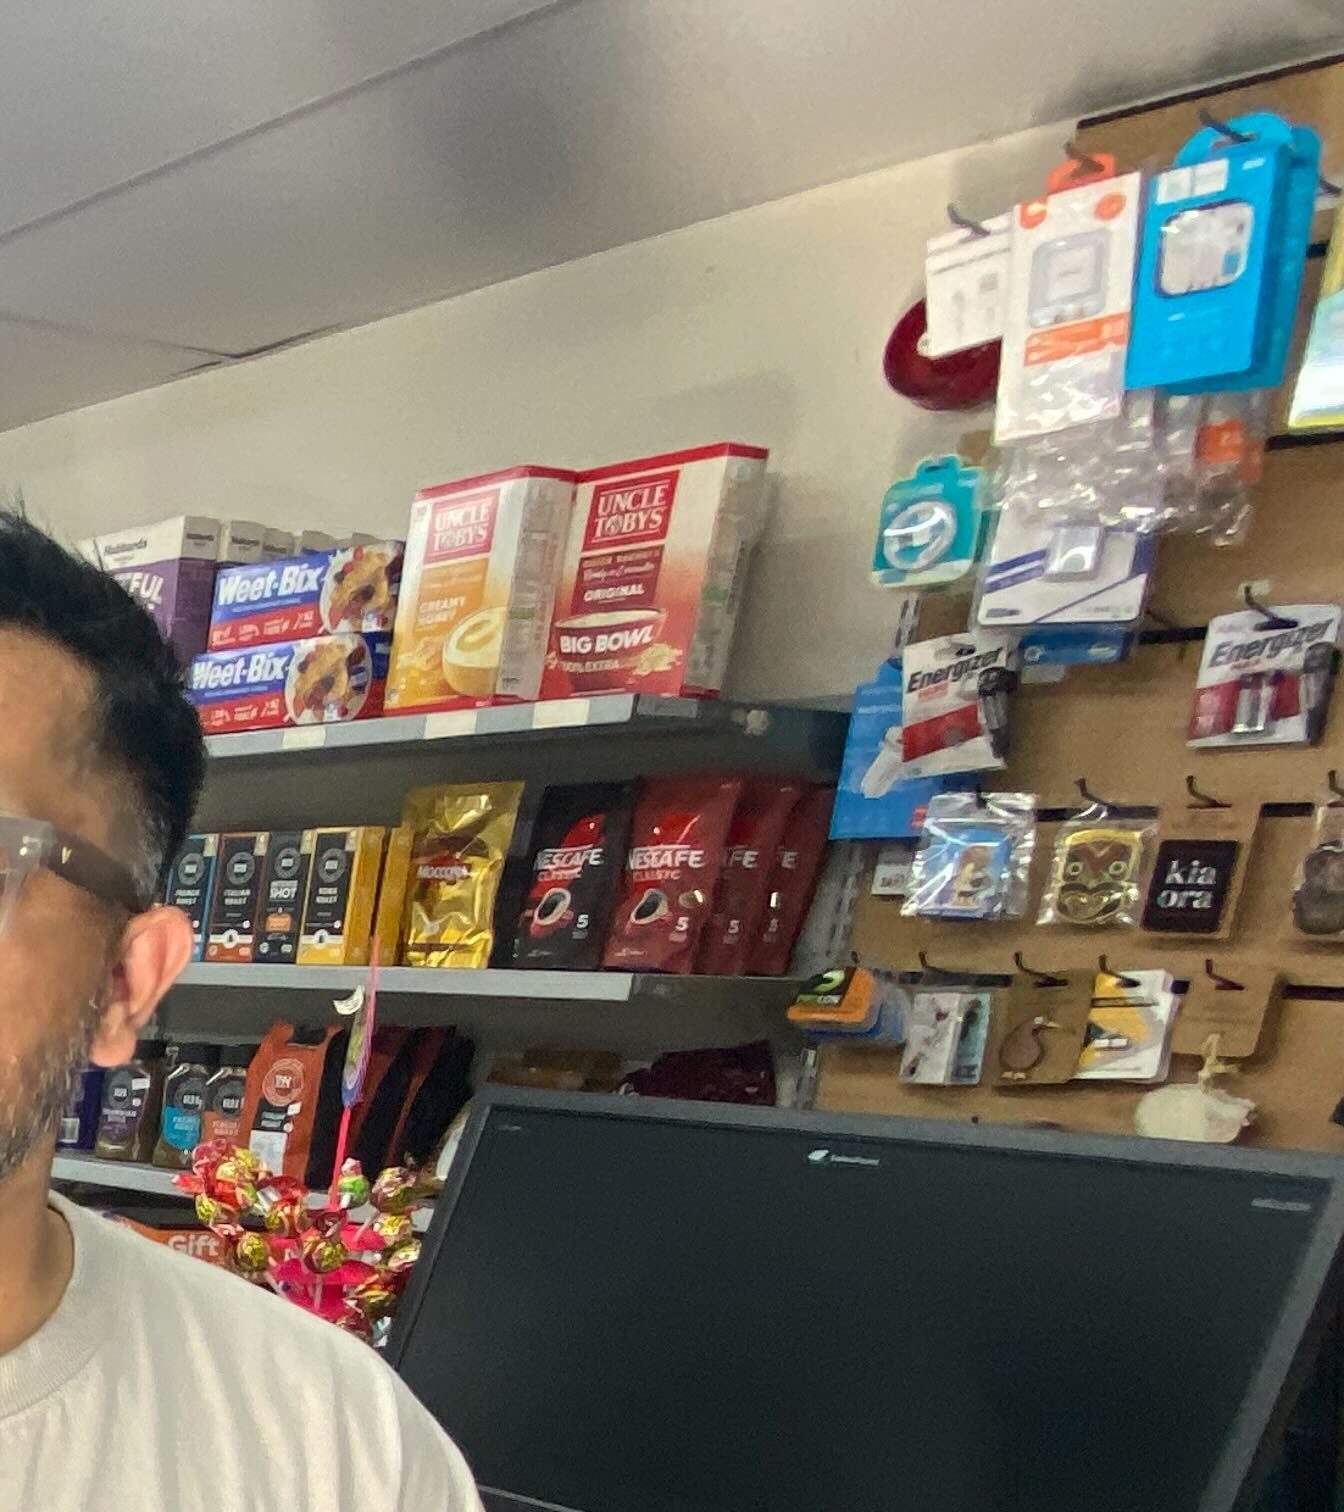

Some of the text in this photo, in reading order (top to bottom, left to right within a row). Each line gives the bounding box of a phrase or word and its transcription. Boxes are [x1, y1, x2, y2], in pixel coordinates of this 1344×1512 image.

[598, 482, 669, 516] UNCLE
[435, 503, 489, 530] UNCLE
[594, 507, 664, 540] TOBYS
[218, 562, 324, 606] Weet-Bix
[584, 584, 645, 602] ORIGINAL
[559, 624, 653, 655] BIG BOWL
[193, 652, 289, 690] Weet-Bix
[1165, 858, 1218, 887] kia
[1157, 884, 1214, 910] ora
